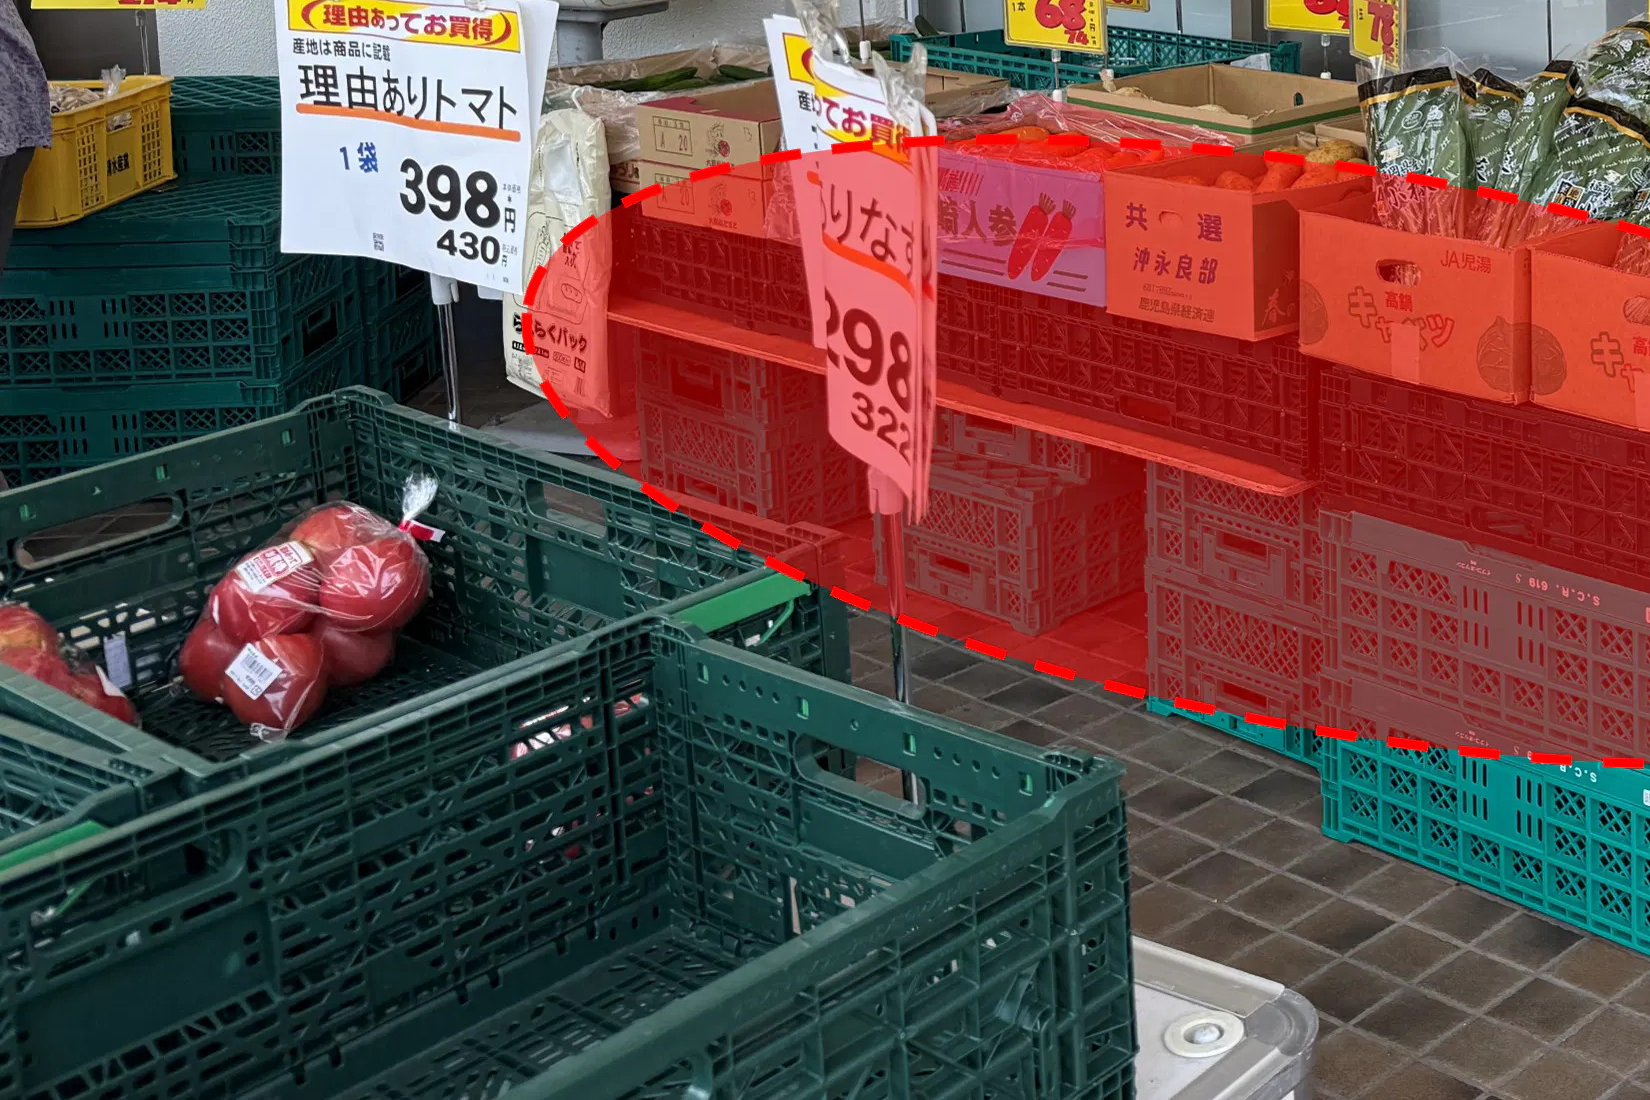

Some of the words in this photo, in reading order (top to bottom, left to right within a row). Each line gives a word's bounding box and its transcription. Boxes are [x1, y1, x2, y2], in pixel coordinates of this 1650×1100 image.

[323, 4, 494, 41] 理由あってお買得
[1064, 30, 1089, 45] 74
[1368, 1, 1395, 46] 78
[292, 38, 391, 62] 産地は商品に記載
[298, 64, 517, 129] 理由ありトマト
[660, 131, 666, 149] A
[678, 134, 688, 151] 20
[340, 142, 379, 173] 1袋
[400, 158, 501, 229] 398
[504, 207, 517, 234] 円
[1125, 202, 1223, 242] 共選
[437, 229, 501, 265] 430
[1441, 250, 1492, 275] JA児湯
[1133, 246, 1218, 284] 沖永良部
[1138, 296, 1215, 323] 鹿児島県経済連
[1385, 291, 1413, 312] 高鍋
